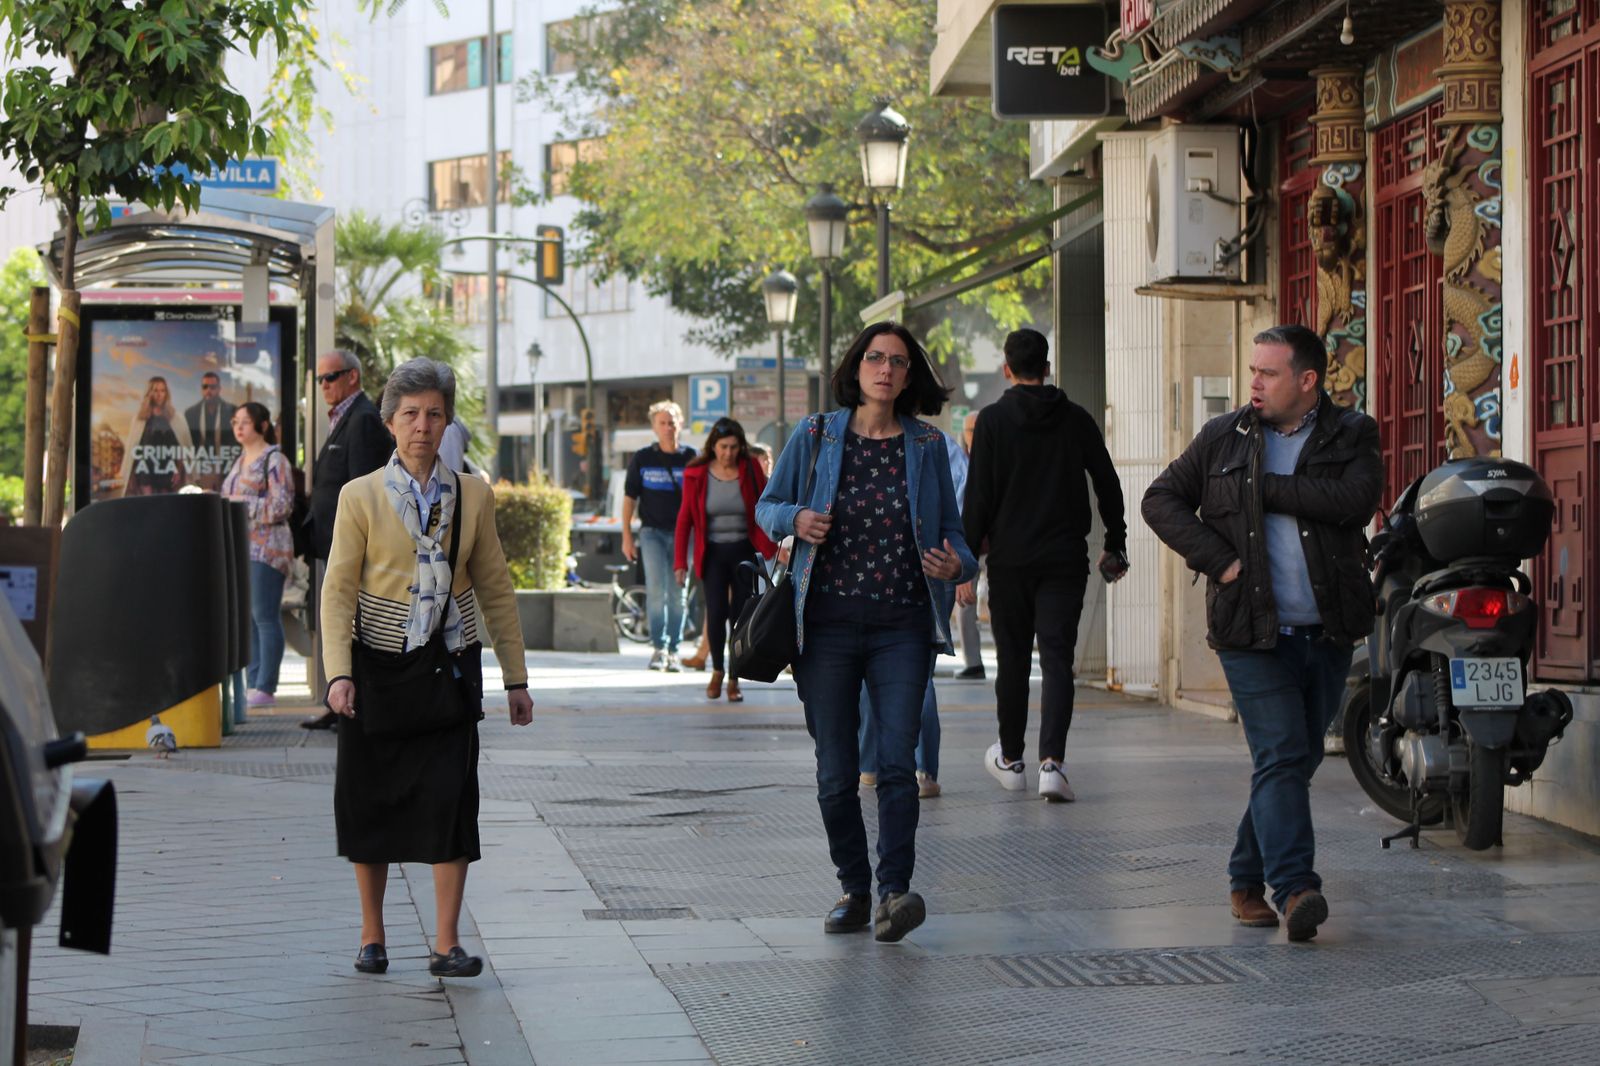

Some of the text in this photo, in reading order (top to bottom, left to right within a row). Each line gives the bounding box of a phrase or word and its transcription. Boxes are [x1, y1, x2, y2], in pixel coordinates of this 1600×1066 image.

[1006, 46, 1080, 72] RETA
[1060, 65, 1081, 76] bet
[697, 380, 722, 410] P
[132, 445, 241, 460] CRIMINALES
[135, 461, 149, 474] A
[153, 461, 178, 475] LA
[1467, 662, 1518, 681] 2345
[1475, 683, 1513, 702] LJG
